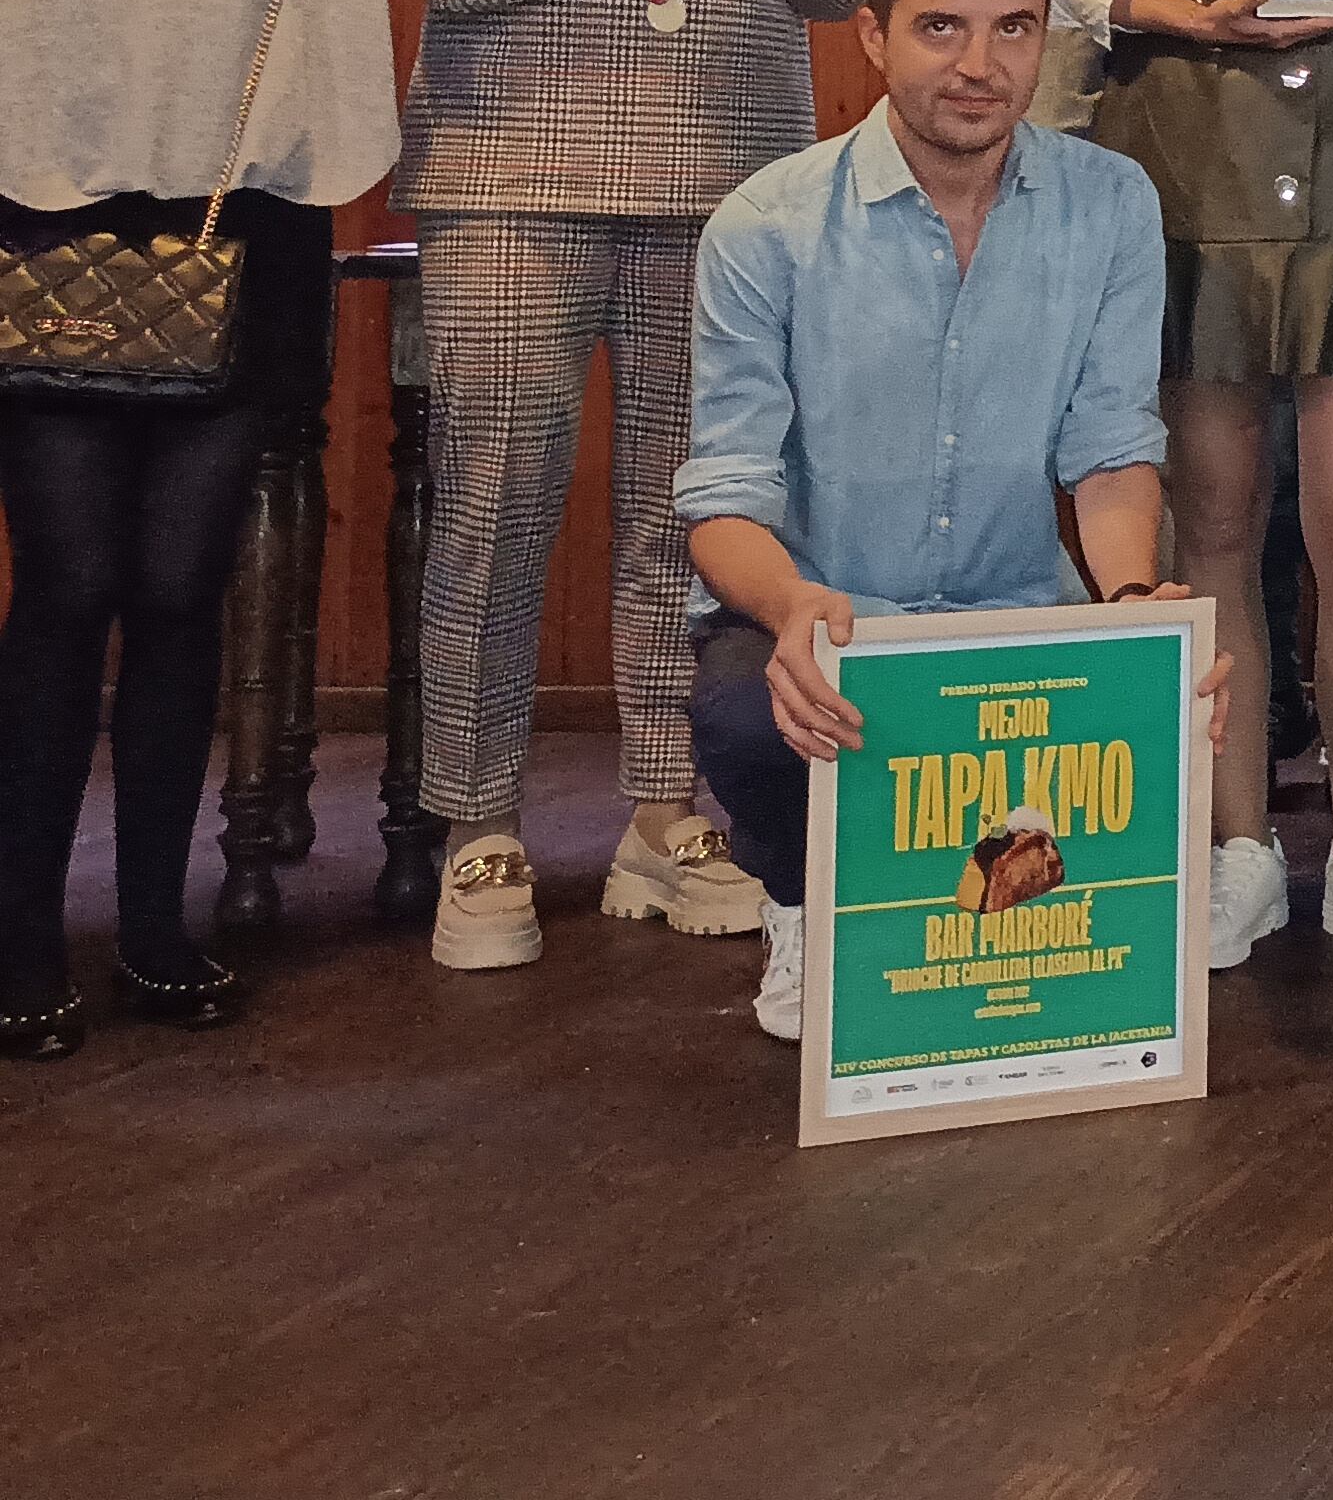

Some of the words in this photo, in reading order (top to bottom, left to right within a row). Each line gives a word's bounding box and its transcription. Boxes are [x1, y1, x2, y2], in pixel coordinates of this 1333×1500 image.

[978, 697, 1050, 741] MEJOR
[888, 750, 1008, 853] TAPA
[1023, 739, 1134, 837] KMO
[925, 912, 975, 961] BAR
[979, 890, 1093, 956] MARBORÉ
